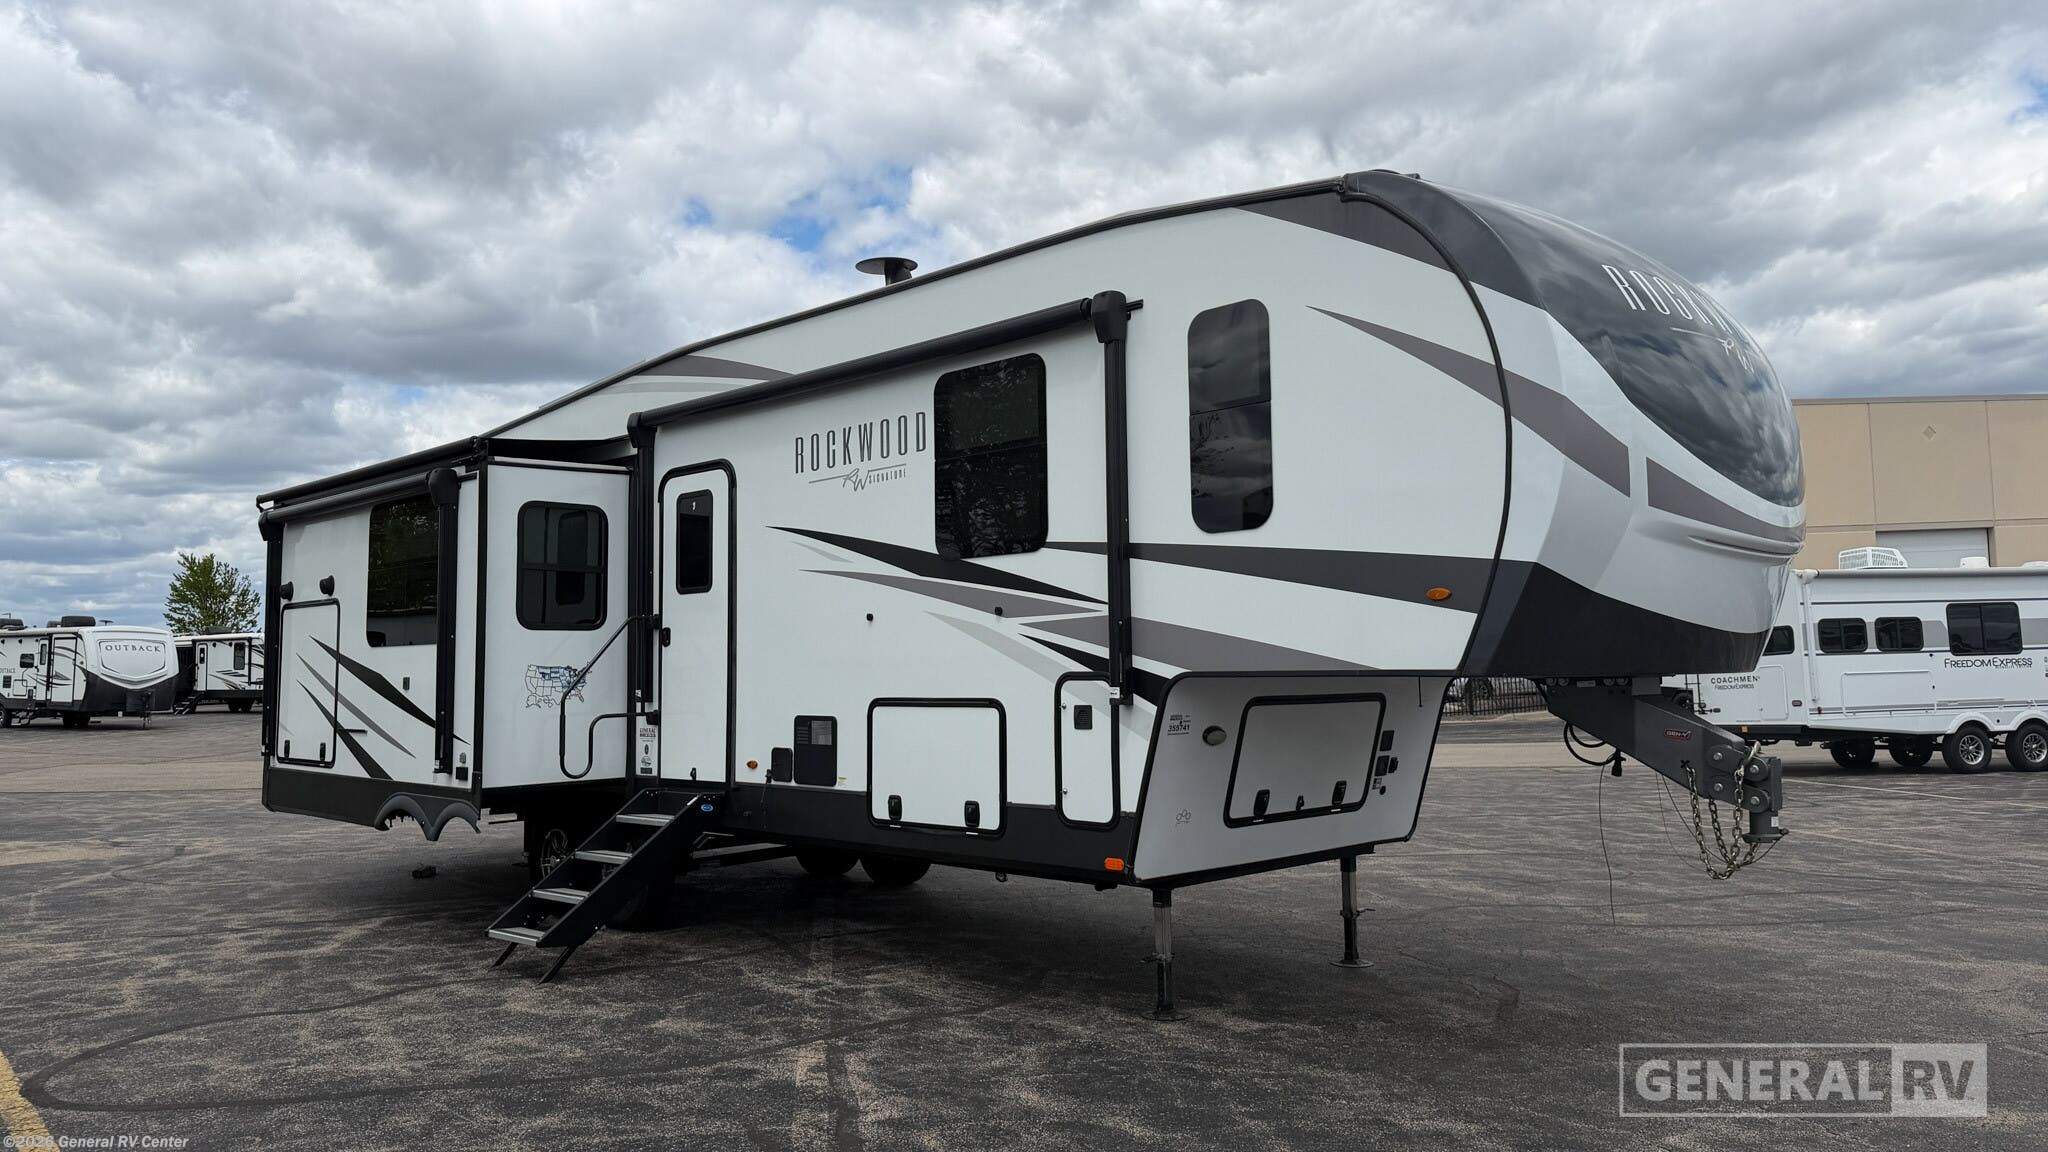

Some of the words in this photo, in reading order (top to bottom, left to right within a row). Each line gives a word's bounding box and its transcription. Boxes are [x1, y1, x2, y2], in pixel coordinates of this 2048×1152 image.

[795, 411, 926, 474] ROCKWOOD
[869, 468, 906, 484] SIGNATURE
[105, 644, 161, 652] OUTBACK
[1710, 675, 1759, 684] COACHMEN
